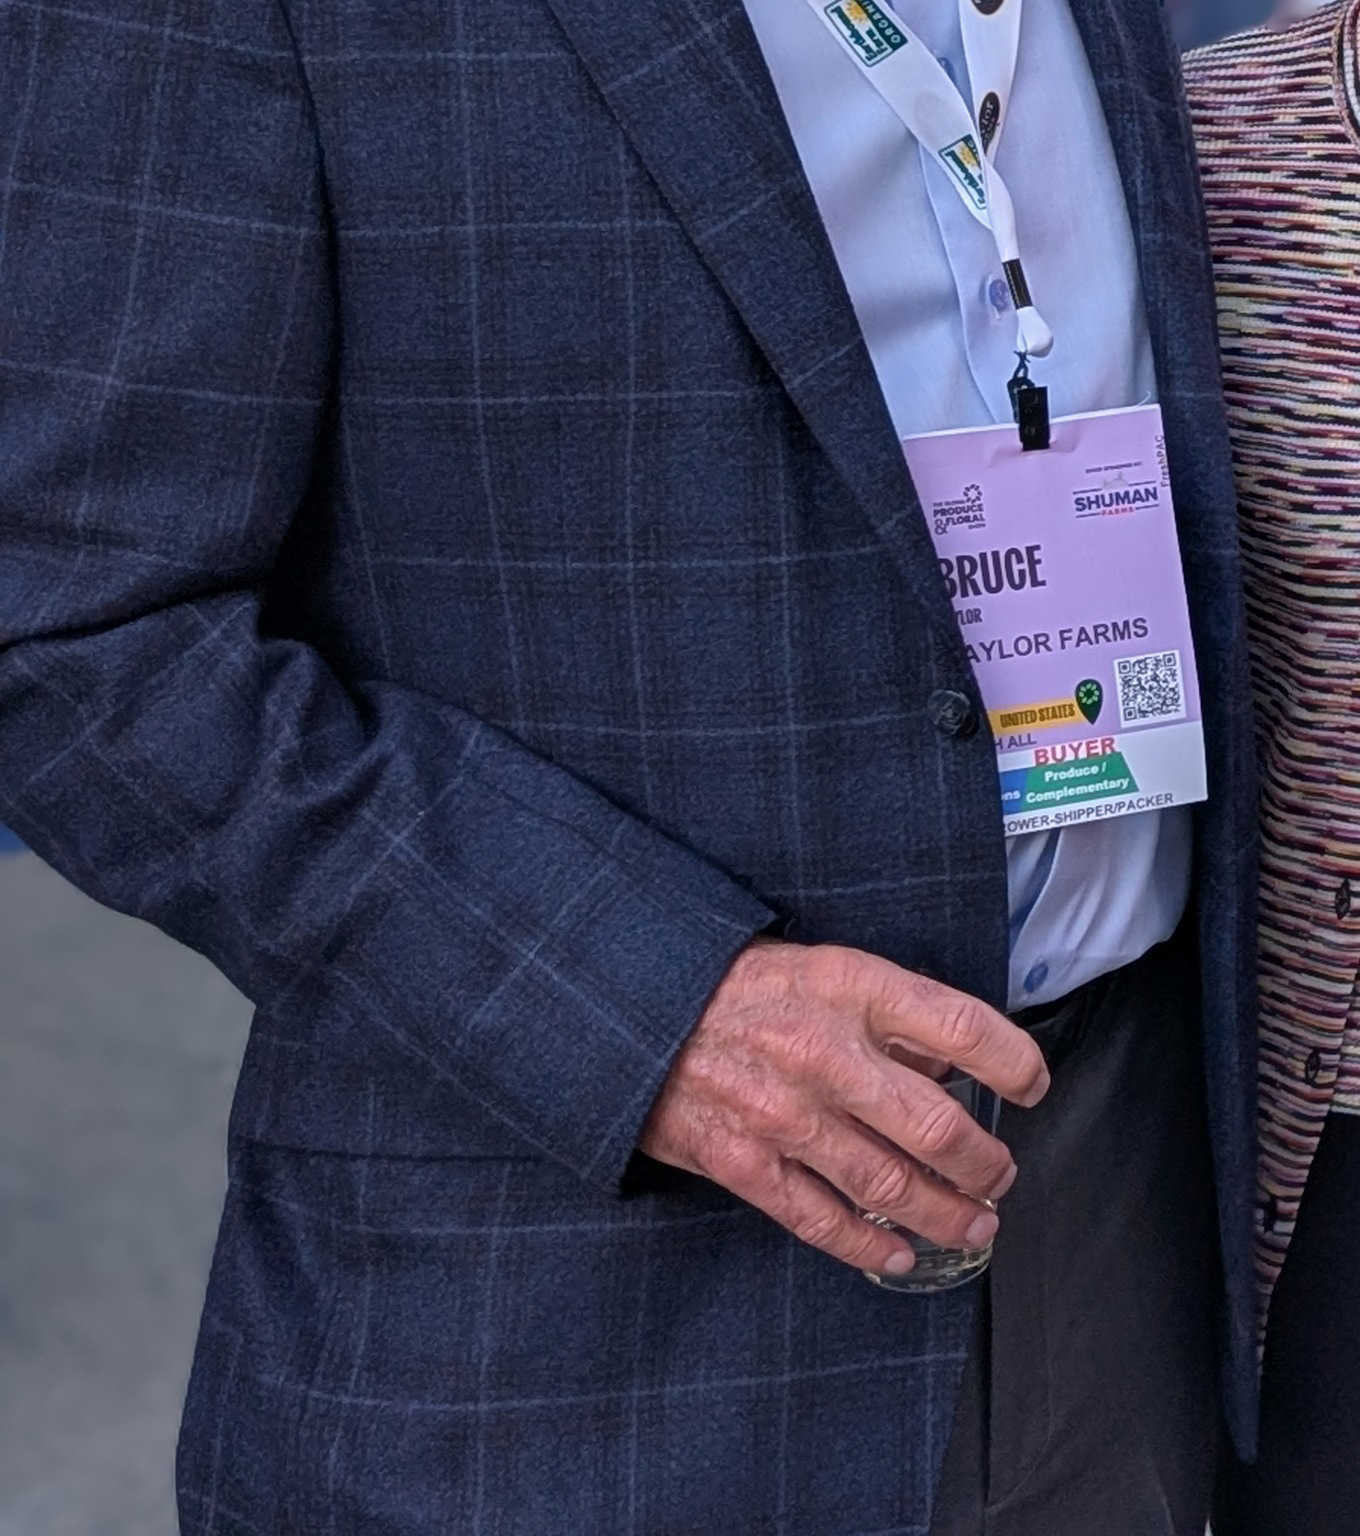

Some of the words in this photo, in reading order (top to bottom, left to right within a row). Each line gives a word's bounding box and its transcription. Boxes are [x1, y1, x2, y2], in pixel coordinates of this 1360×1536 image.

[933, 503, 984, 517] PRODUCE
[1074, 486, 1158, 512] SHUMAN
[945, 513, 986, 526] FLORAL
[938, 544, 1047, 599] BRUCE
[965, 632, 1053, 664] AYLOR
[1058, 617, 1149, 650] FARMS
[1000, 709, 1038, 729] UNITED
[1038, 703, 1076, 723] STATES
[1007, 732, 1037, 750] ALL
[1034, 737, 1116, 766] BUYER
[1044, 764, 1099, 782] Produce
[1026, 776, 1130, 804] Complementary
